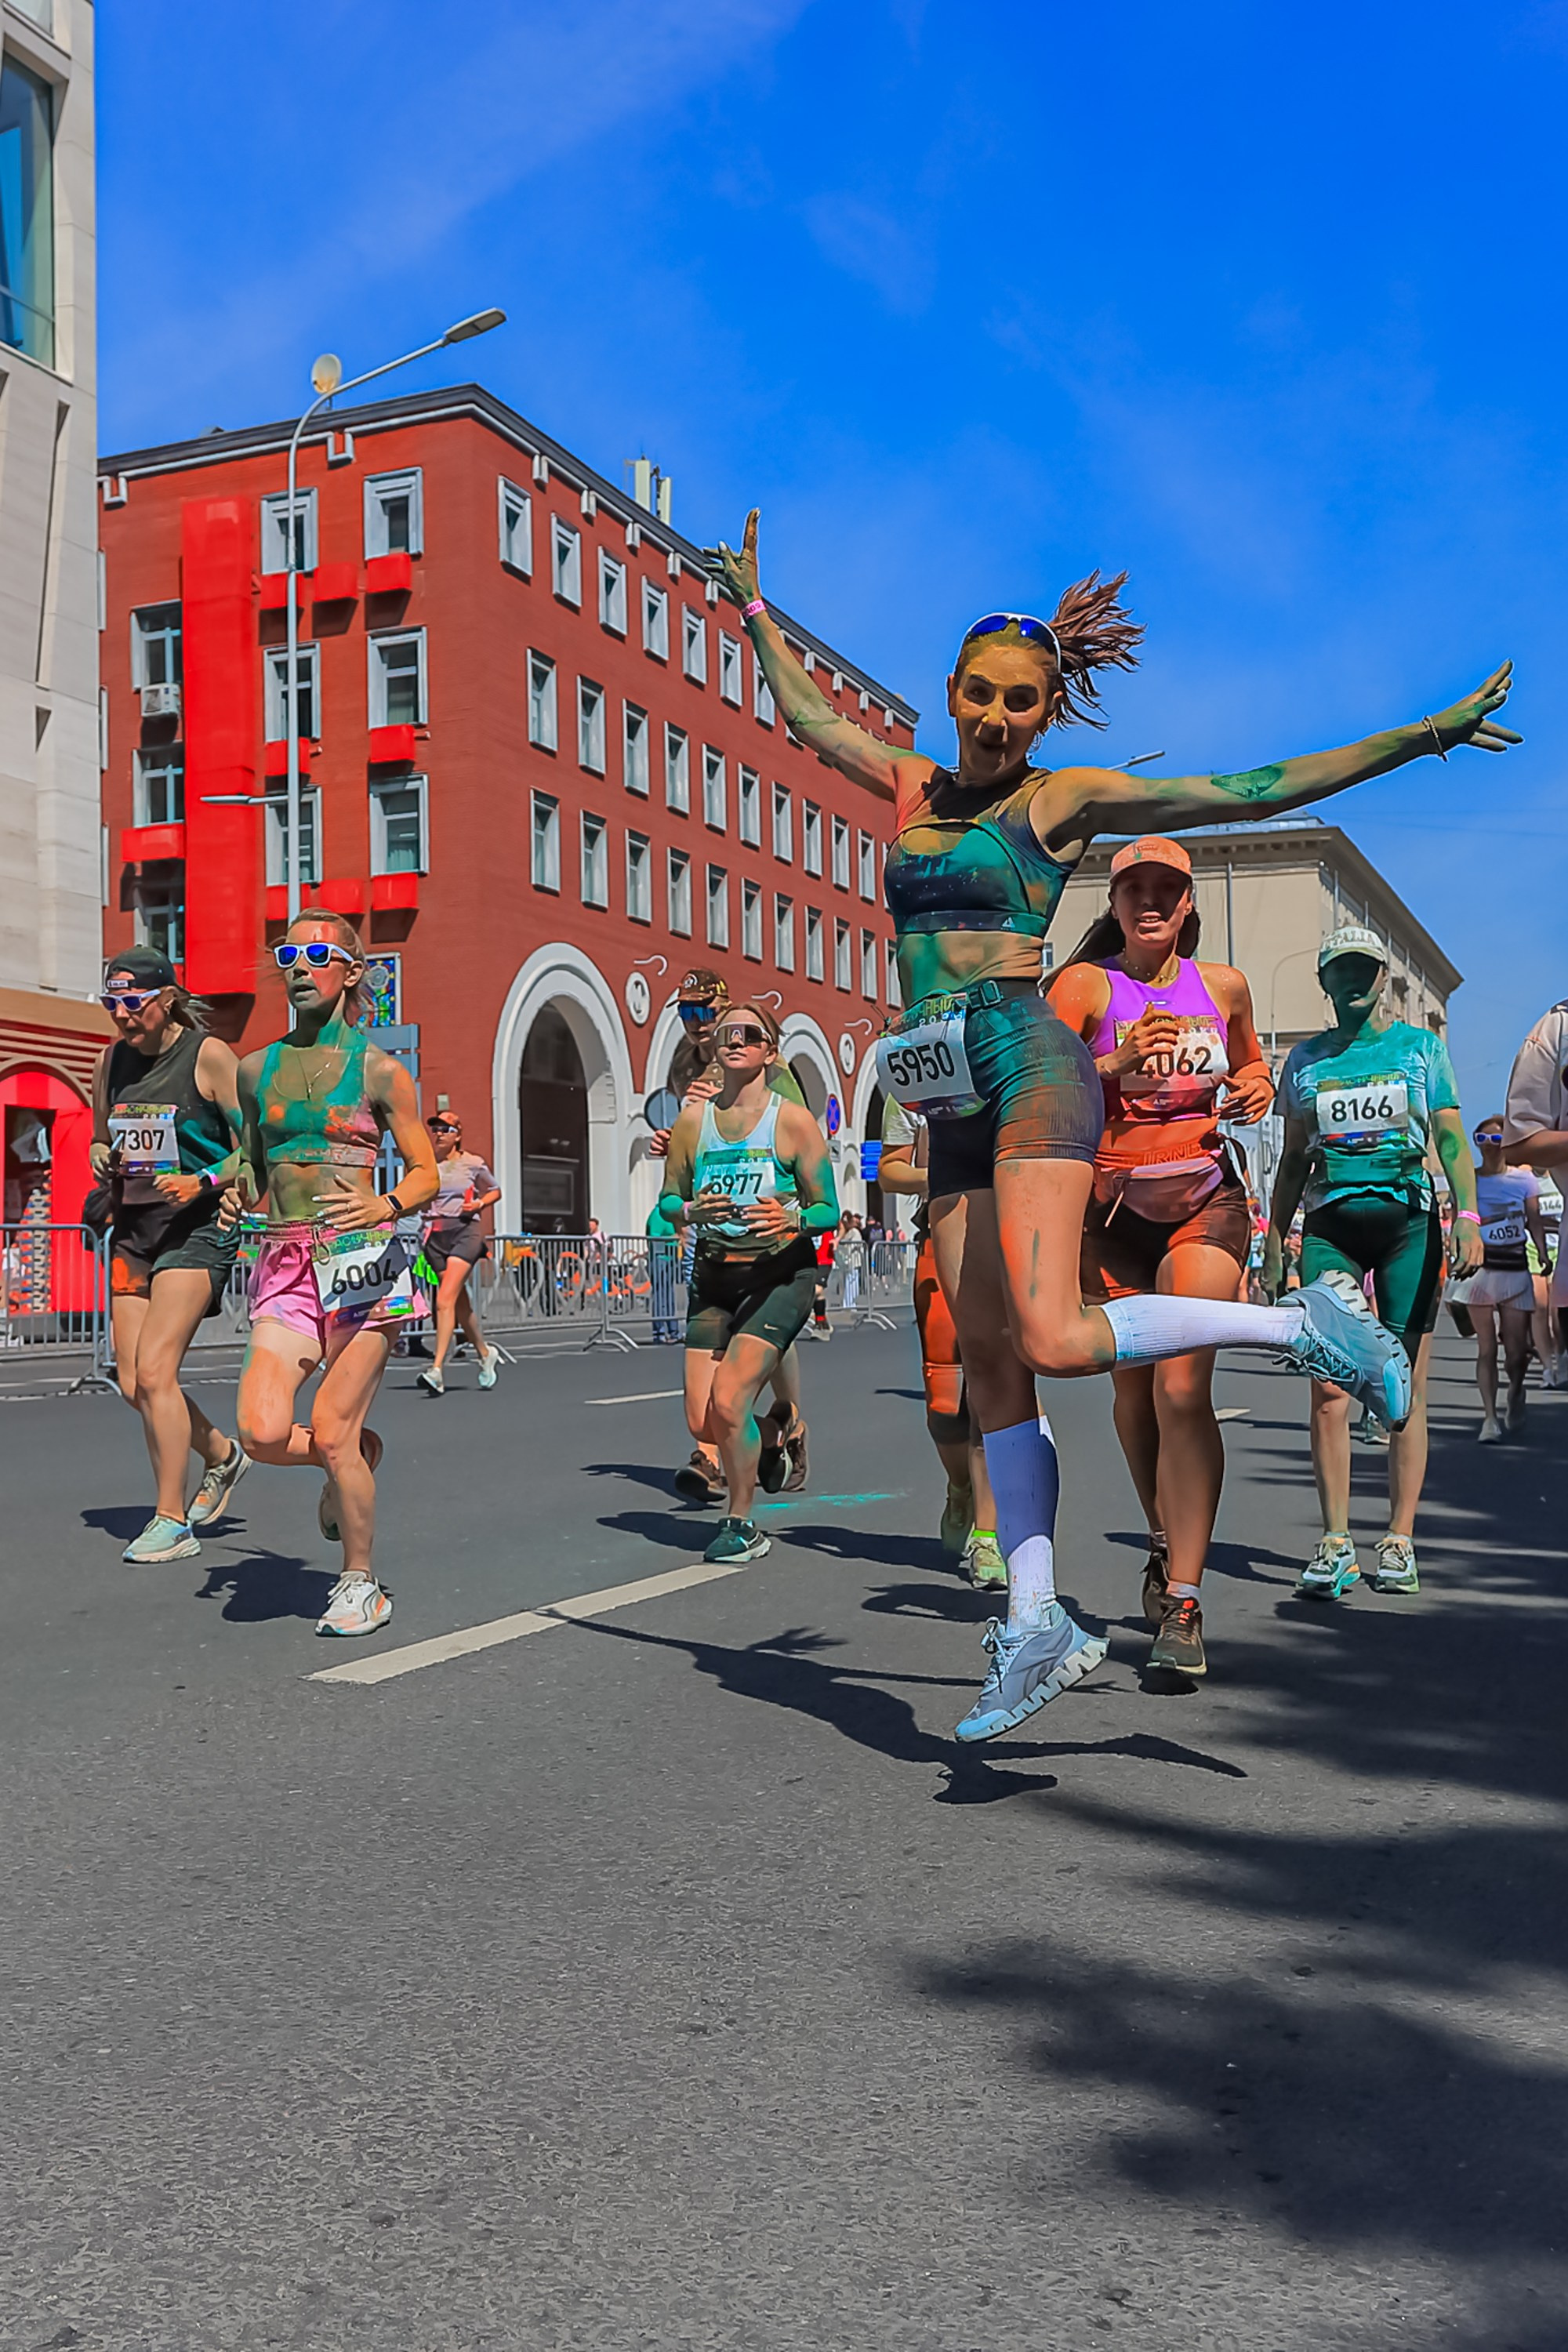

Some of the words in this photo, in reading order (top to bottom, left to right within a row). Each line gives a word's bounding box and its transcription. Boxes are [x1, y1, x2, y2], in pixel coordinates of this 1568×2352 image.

[887, 1041, 955, 1086] 5950
[1136, 1046, 1214, 1078] 4062
[1331, 1095, 1393, 1122] 8166
[116, 1129, 165, 1151] 7307
[710, 1173, 763, 1195] 5977
[1489, 1225, 1521, 1240] 6052
[331, 1258, 399, 1294] 6004
